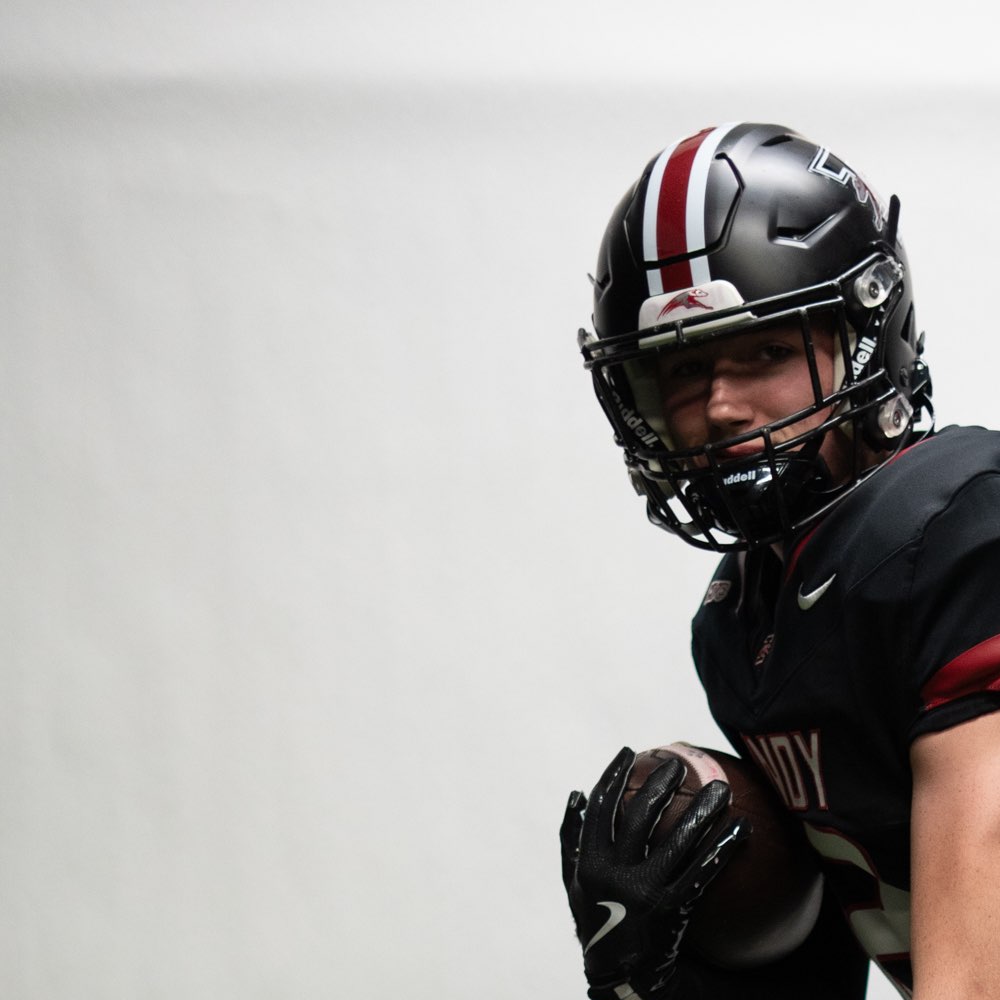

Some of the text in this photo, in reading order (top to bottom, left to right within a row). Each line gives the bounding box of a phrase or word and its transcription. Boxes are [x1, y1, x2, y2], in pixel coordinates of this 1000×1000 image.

[852, 336, 878, 379] dell
[722, 469, 756, 486] iddell
[741, 728, 828, 811] NDY
